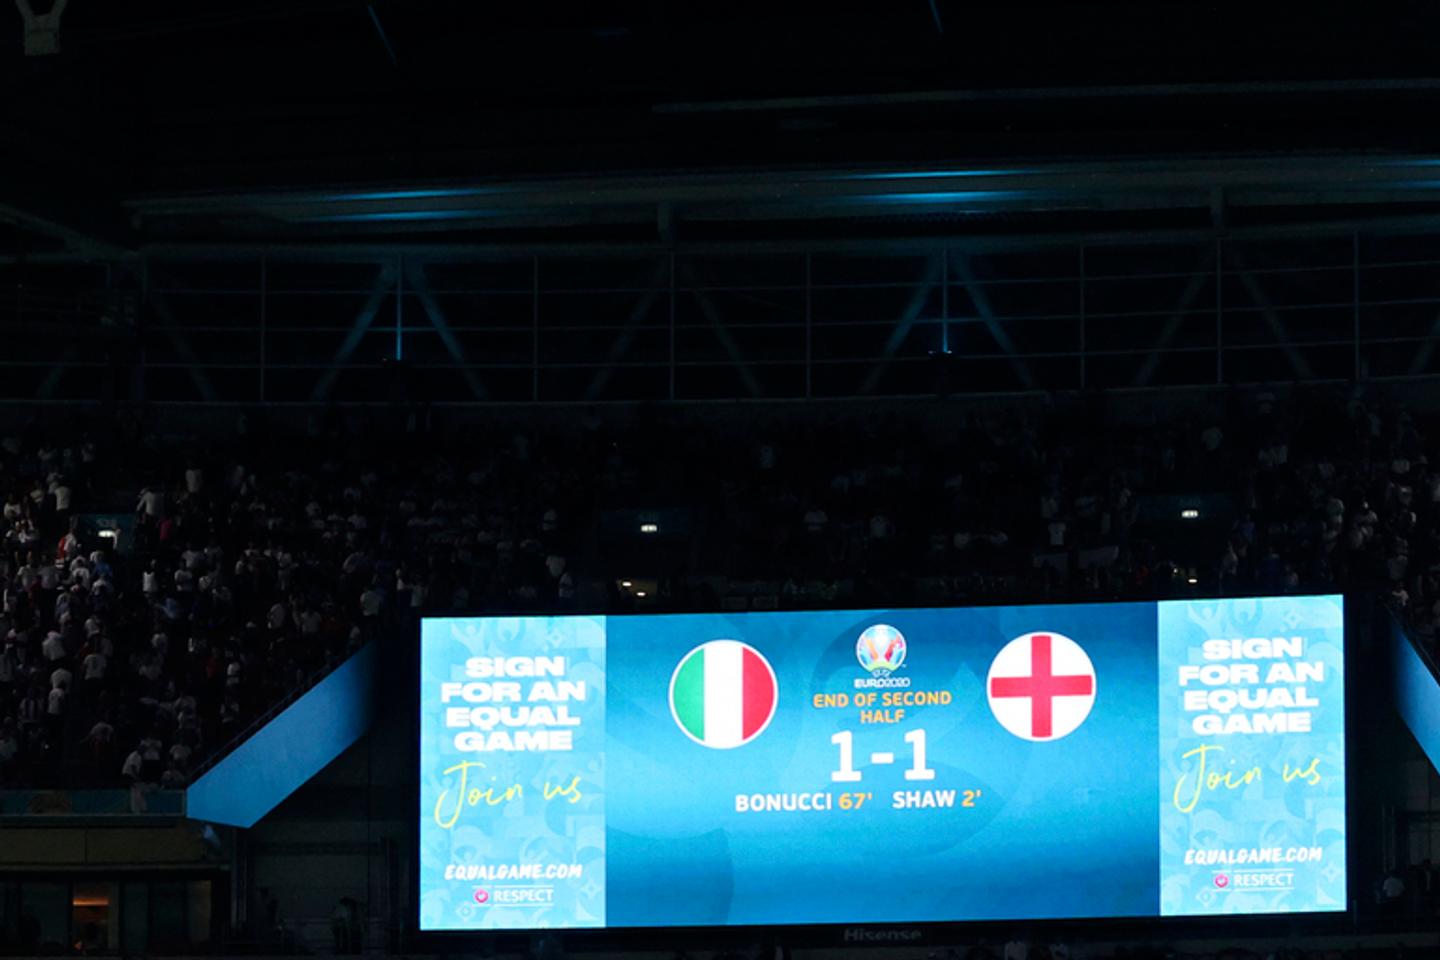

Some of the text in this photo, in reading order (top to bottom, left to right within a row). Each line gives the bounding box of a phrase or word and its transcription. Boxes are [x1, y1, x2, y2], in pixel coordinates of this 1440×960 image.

[1202, 636, 1303, 660] SIGN
[465, 656, 564, 678] SIGN
[1178, 661, 1325, 687] FOR AN
[441, 680, 586, 703] FOR AN
[813, 690, 952, 708] END OF SECOND
[1183, 687, 1319, 711] EQUAL
[446, 706, 581, 728] EQUAL
[860, 709, 905, 724] HALF
[1191, 712, 1312, 735] GAME
[454, 731, 573, 752] GAME
[1173, 744, 1322, 814] Join us
[434, 760, 583, 829] Join us
[735, 793, 832, 812] BONUCCI
[892, 789, 956, 808] SHAW
[1184, 846, 1323, 865] EQUALGAME.COM
[444, 864, 583, 881] EQUALGAME.COM
[1233, 872, 1294, 887] RESPECT
[494, 888, 554, 903] RESPECT
[843, 927, 923, 941] Hisense
